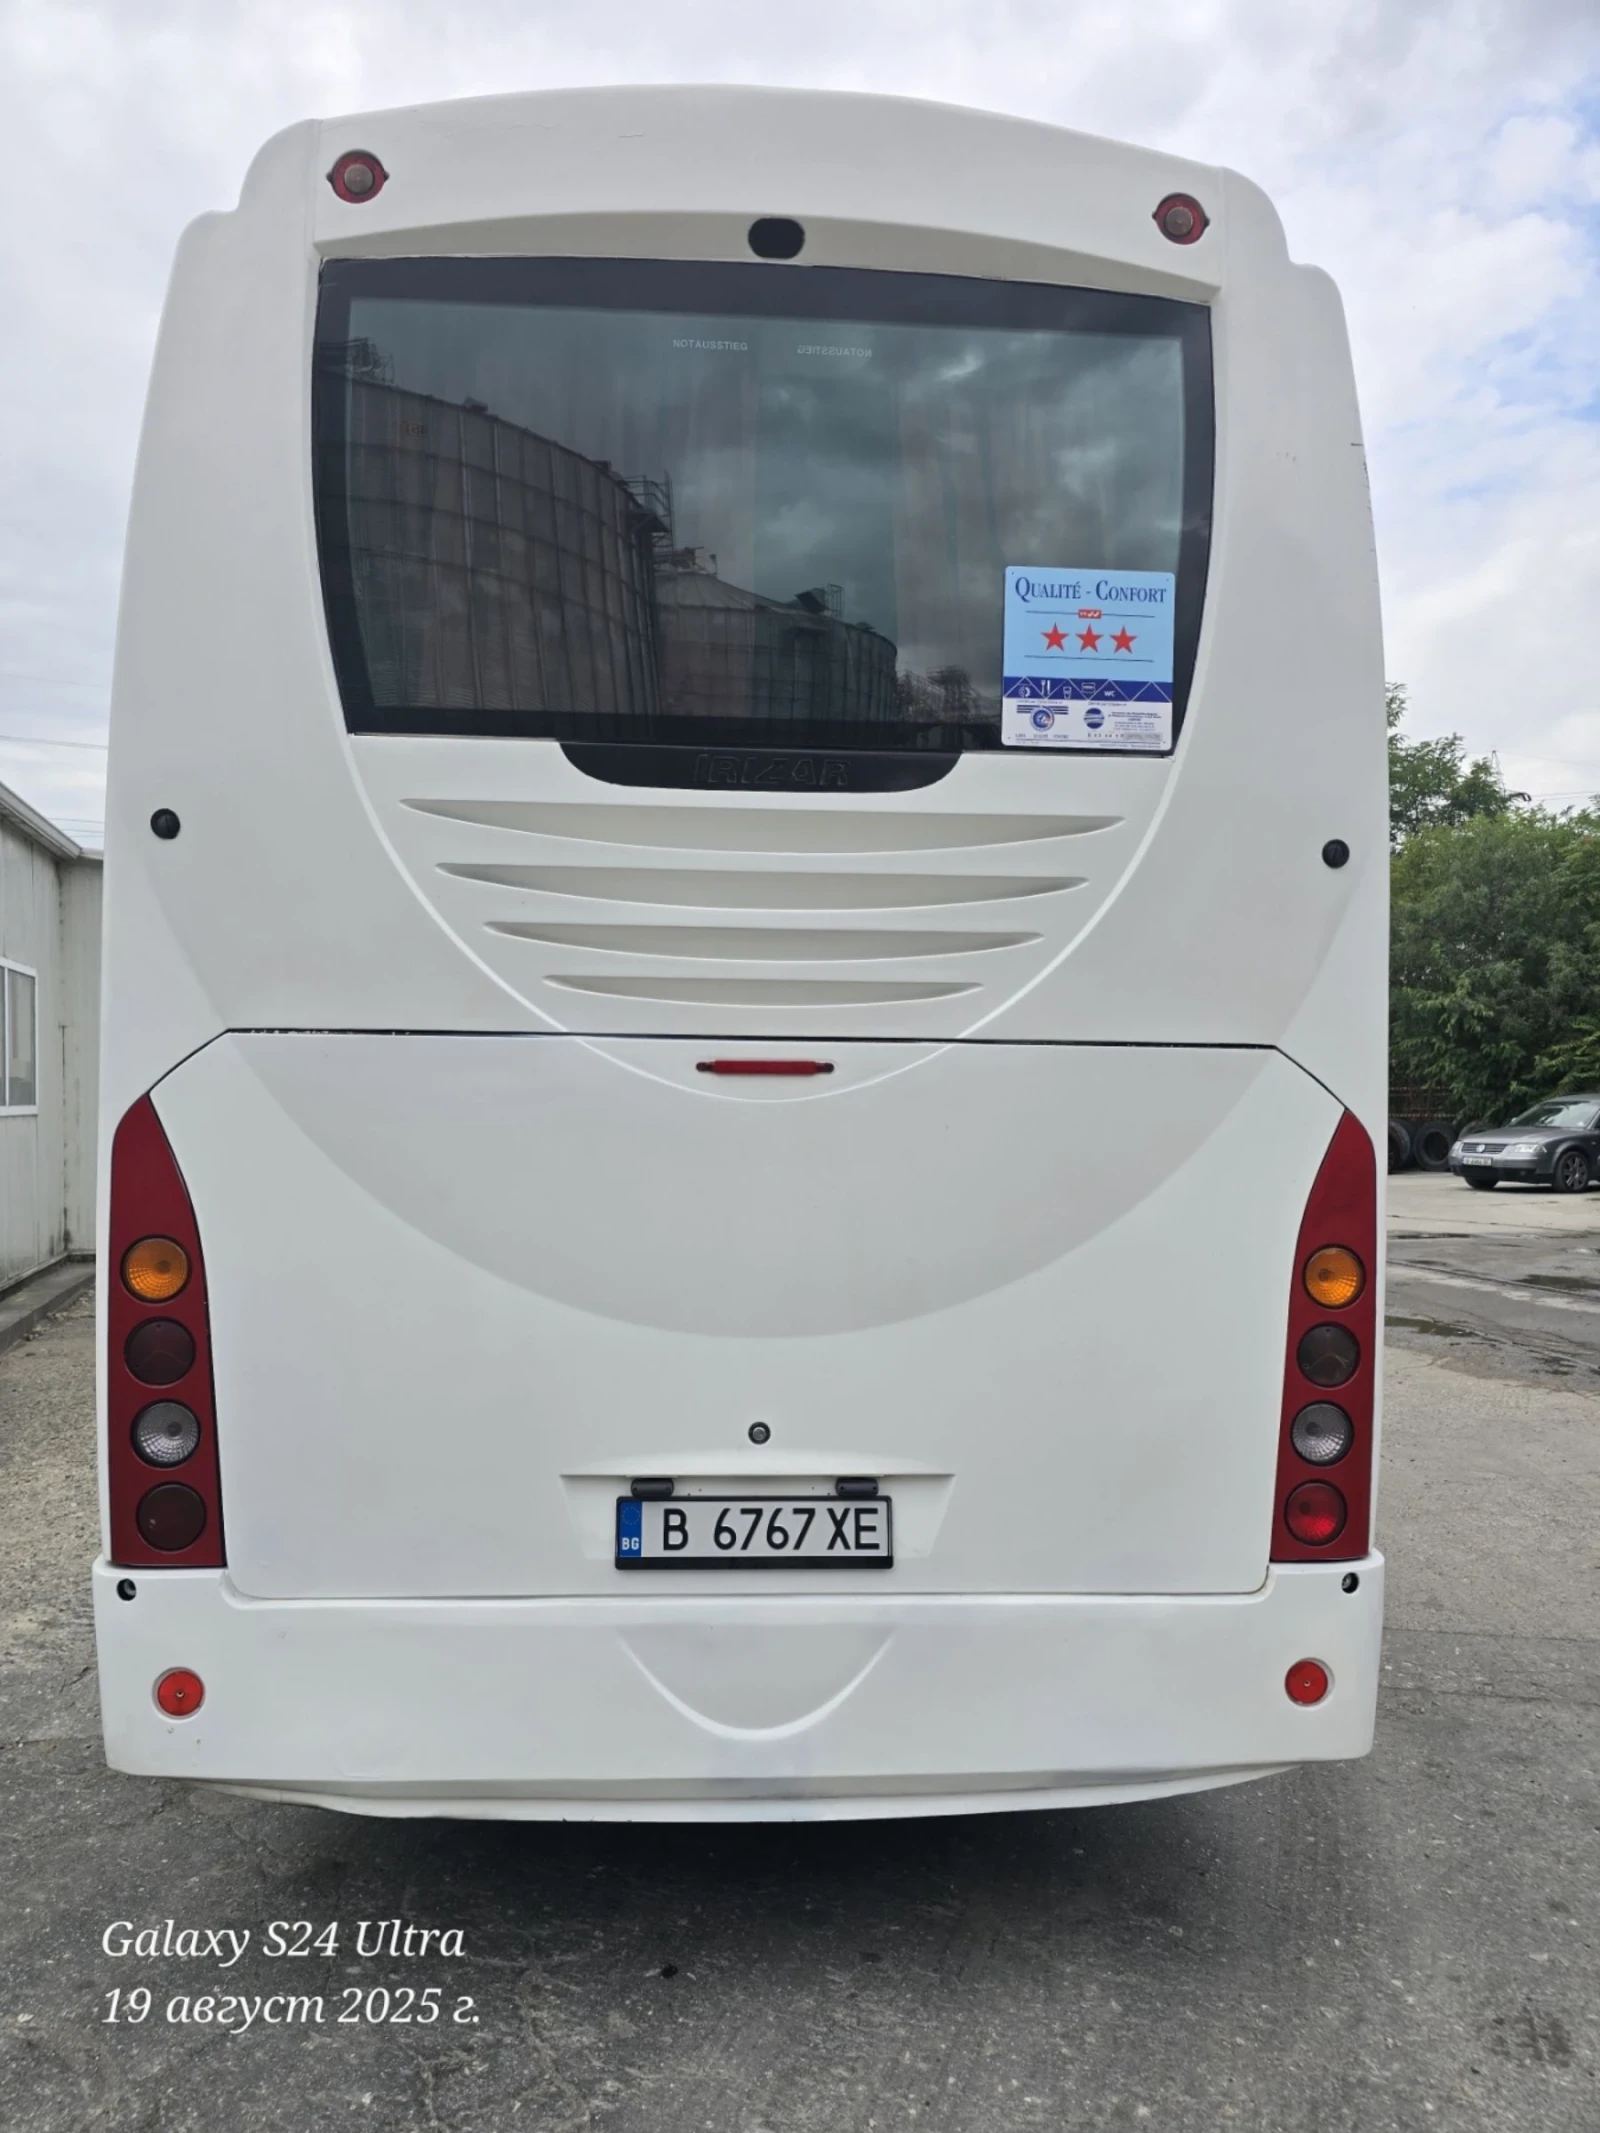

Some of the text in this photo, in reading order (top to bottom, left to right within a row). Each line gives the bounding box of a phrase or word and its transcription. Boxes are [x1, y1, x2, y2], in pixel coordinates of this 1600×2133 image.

[672, 339, 748, 351] NOTAUSSTIEG
[1103, 690, 1116, 698] WC
[693, 754, 851, 787] IRIZAR
[663, 1507, 880, 1551] B 6767 XE
[621, 1537, 640, 1551] BG
